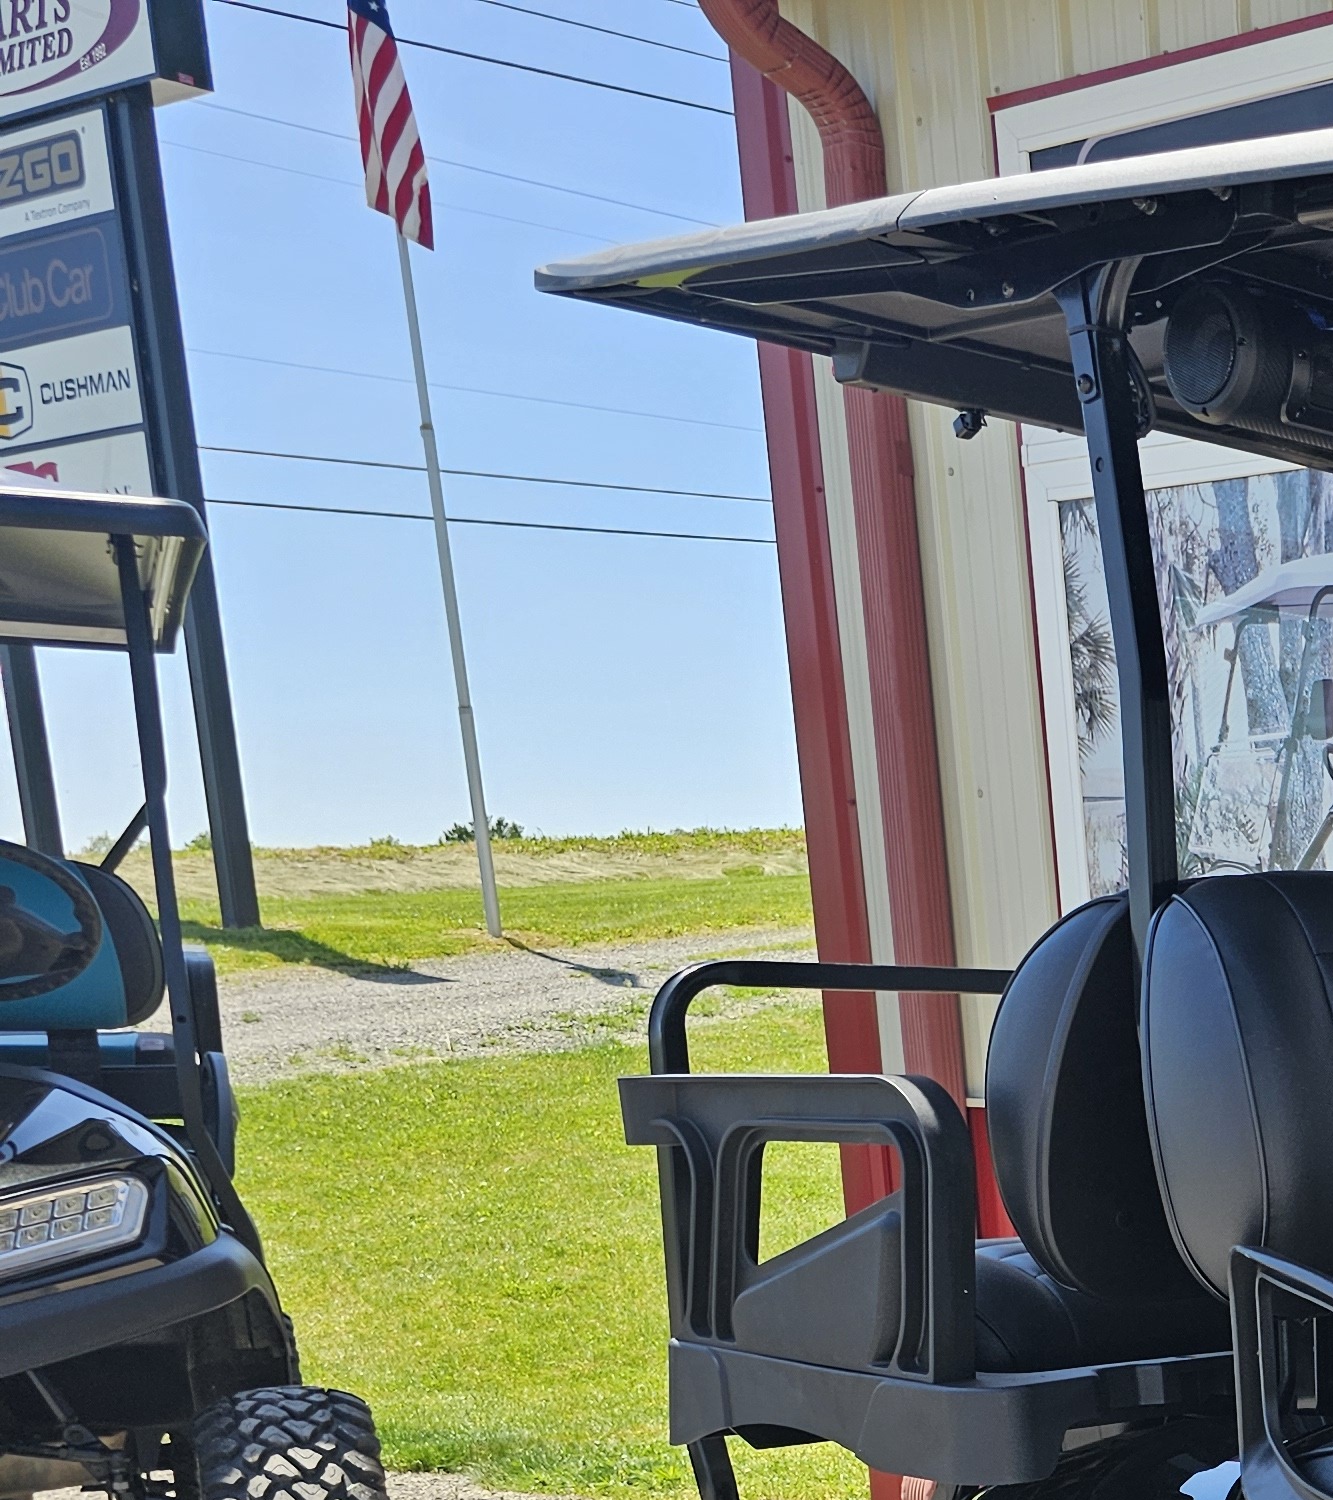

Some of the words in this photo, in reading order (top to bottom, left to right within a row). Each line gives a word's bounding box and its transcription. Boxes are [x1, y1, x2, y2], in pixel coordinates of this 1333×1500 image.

[0, 0, 71, 40] RTS
[46, 259, 94, 308] Car
[40, 367, 131, 405] CUSHMAN
